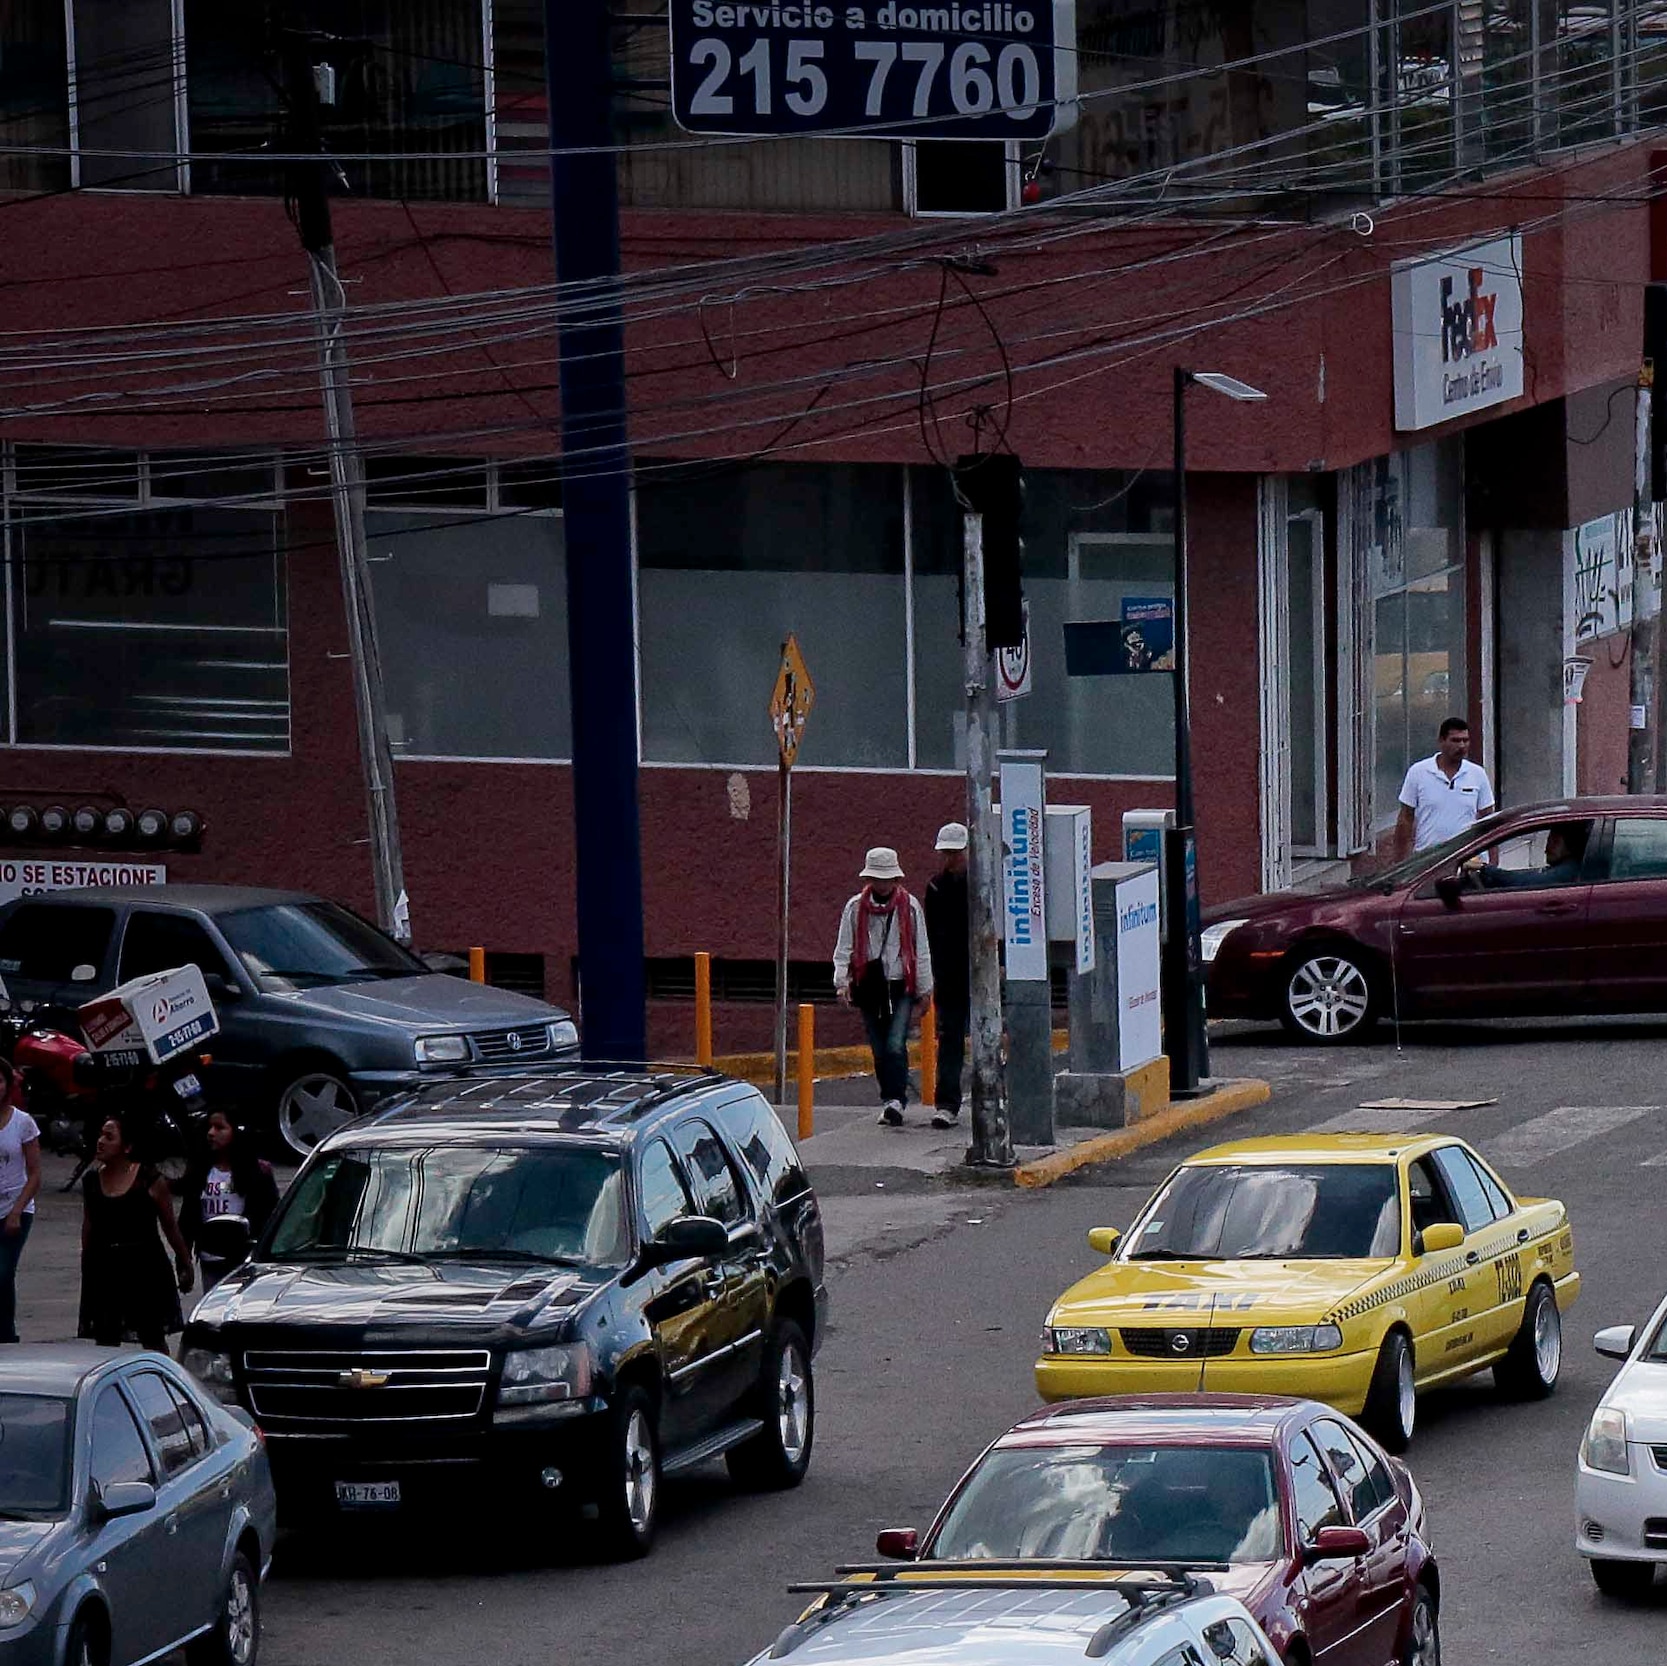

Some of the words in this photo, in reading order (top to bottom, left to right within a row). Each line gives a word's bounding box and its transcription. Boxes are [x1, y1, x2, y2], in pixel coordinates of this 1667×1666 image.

[692, 0, 834, 30] Servicio
[845, 10, 866, 30] a
[876, 1, 1036, 34] domicilio
[688, 37, 829, 117] 215
[854, 40, 1041, 121] 7760
[1030, 806, 1042, 863] Velocidad
[23, 865, 45, 884] SE
[52, 866, 157, 886] ESTACIONE
[1007, 807, 1031, 945] infinitum
[1031, 865, 1041, 878] de
[1030, 880, 1042, 917] Exceso
[1119, 902, 1157, 933] infinitum
